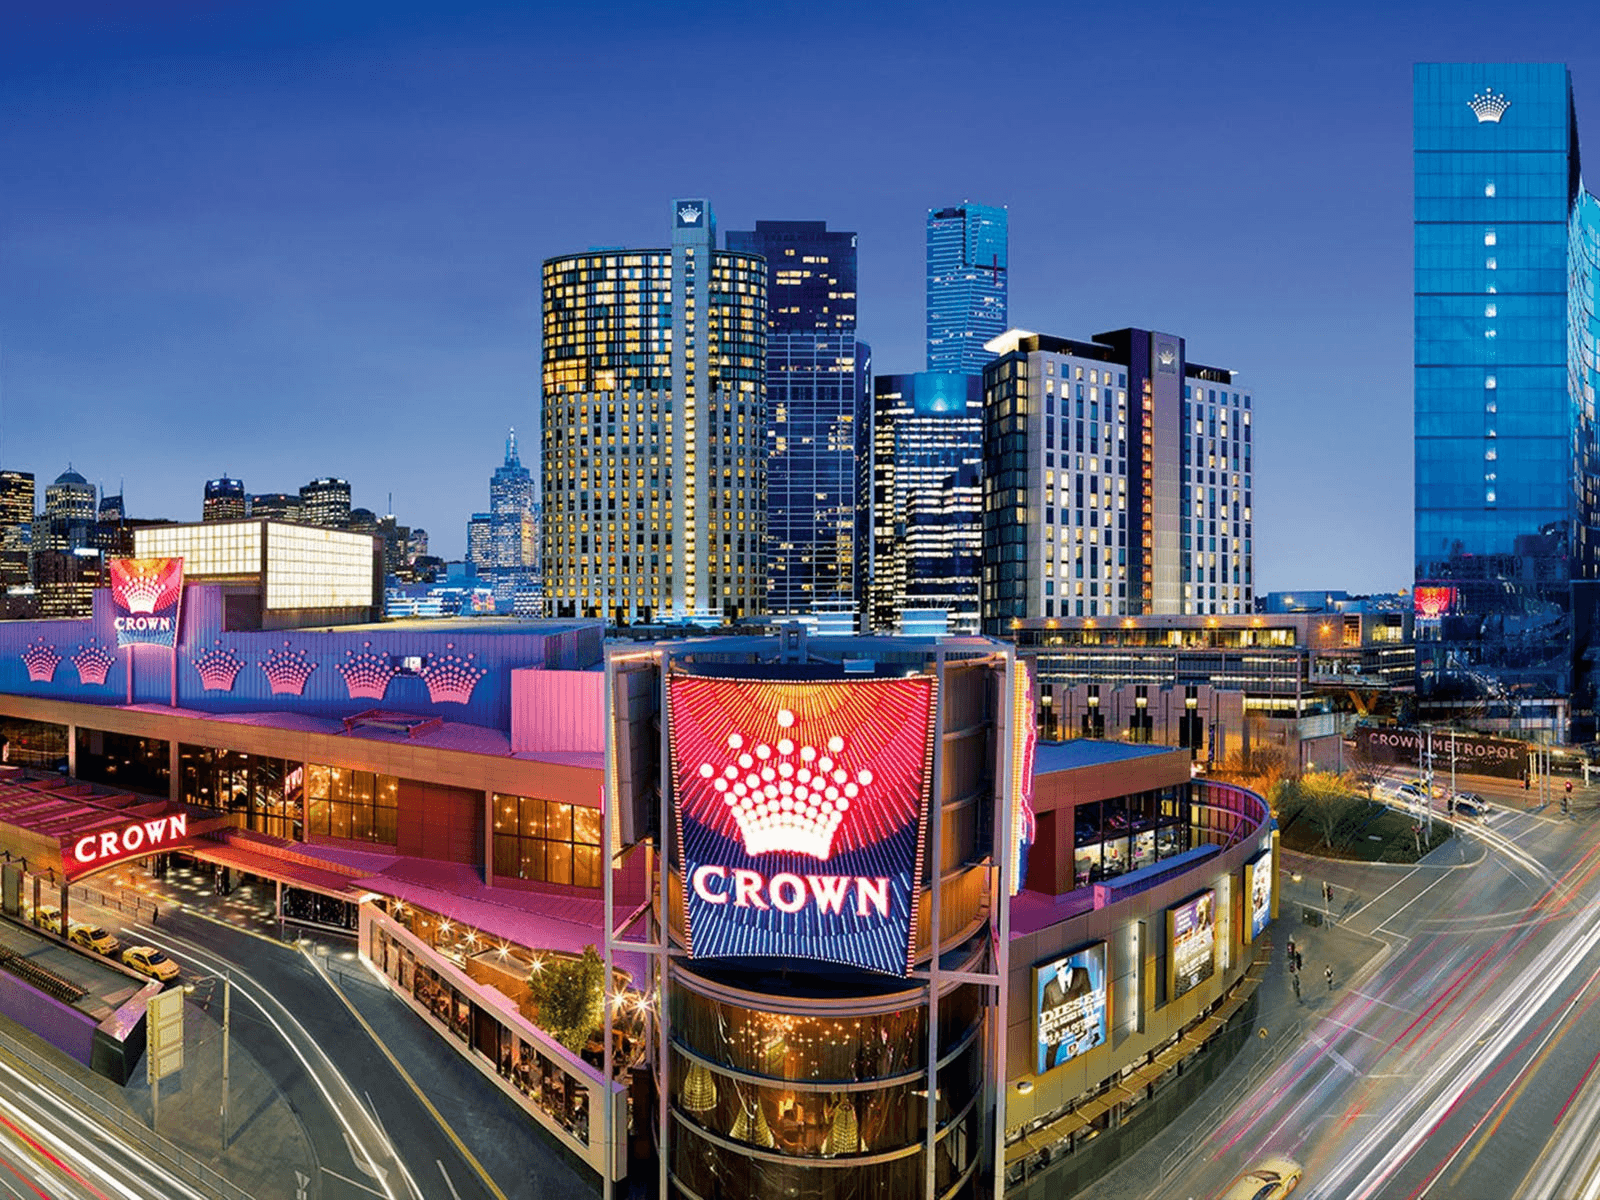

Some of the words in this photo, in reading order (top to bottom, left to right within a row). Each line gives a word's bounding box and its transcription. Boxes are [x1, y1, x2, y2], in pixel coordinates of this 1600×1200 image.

[114, 616, 170, 630] CROWN
[1369, 733, 1424, 749] CROWN
[75, 813, 186, 862] CROWN
[693, 865, 892, 918] CROWN
[1039, 988, 1106, 1024] DIESEL
